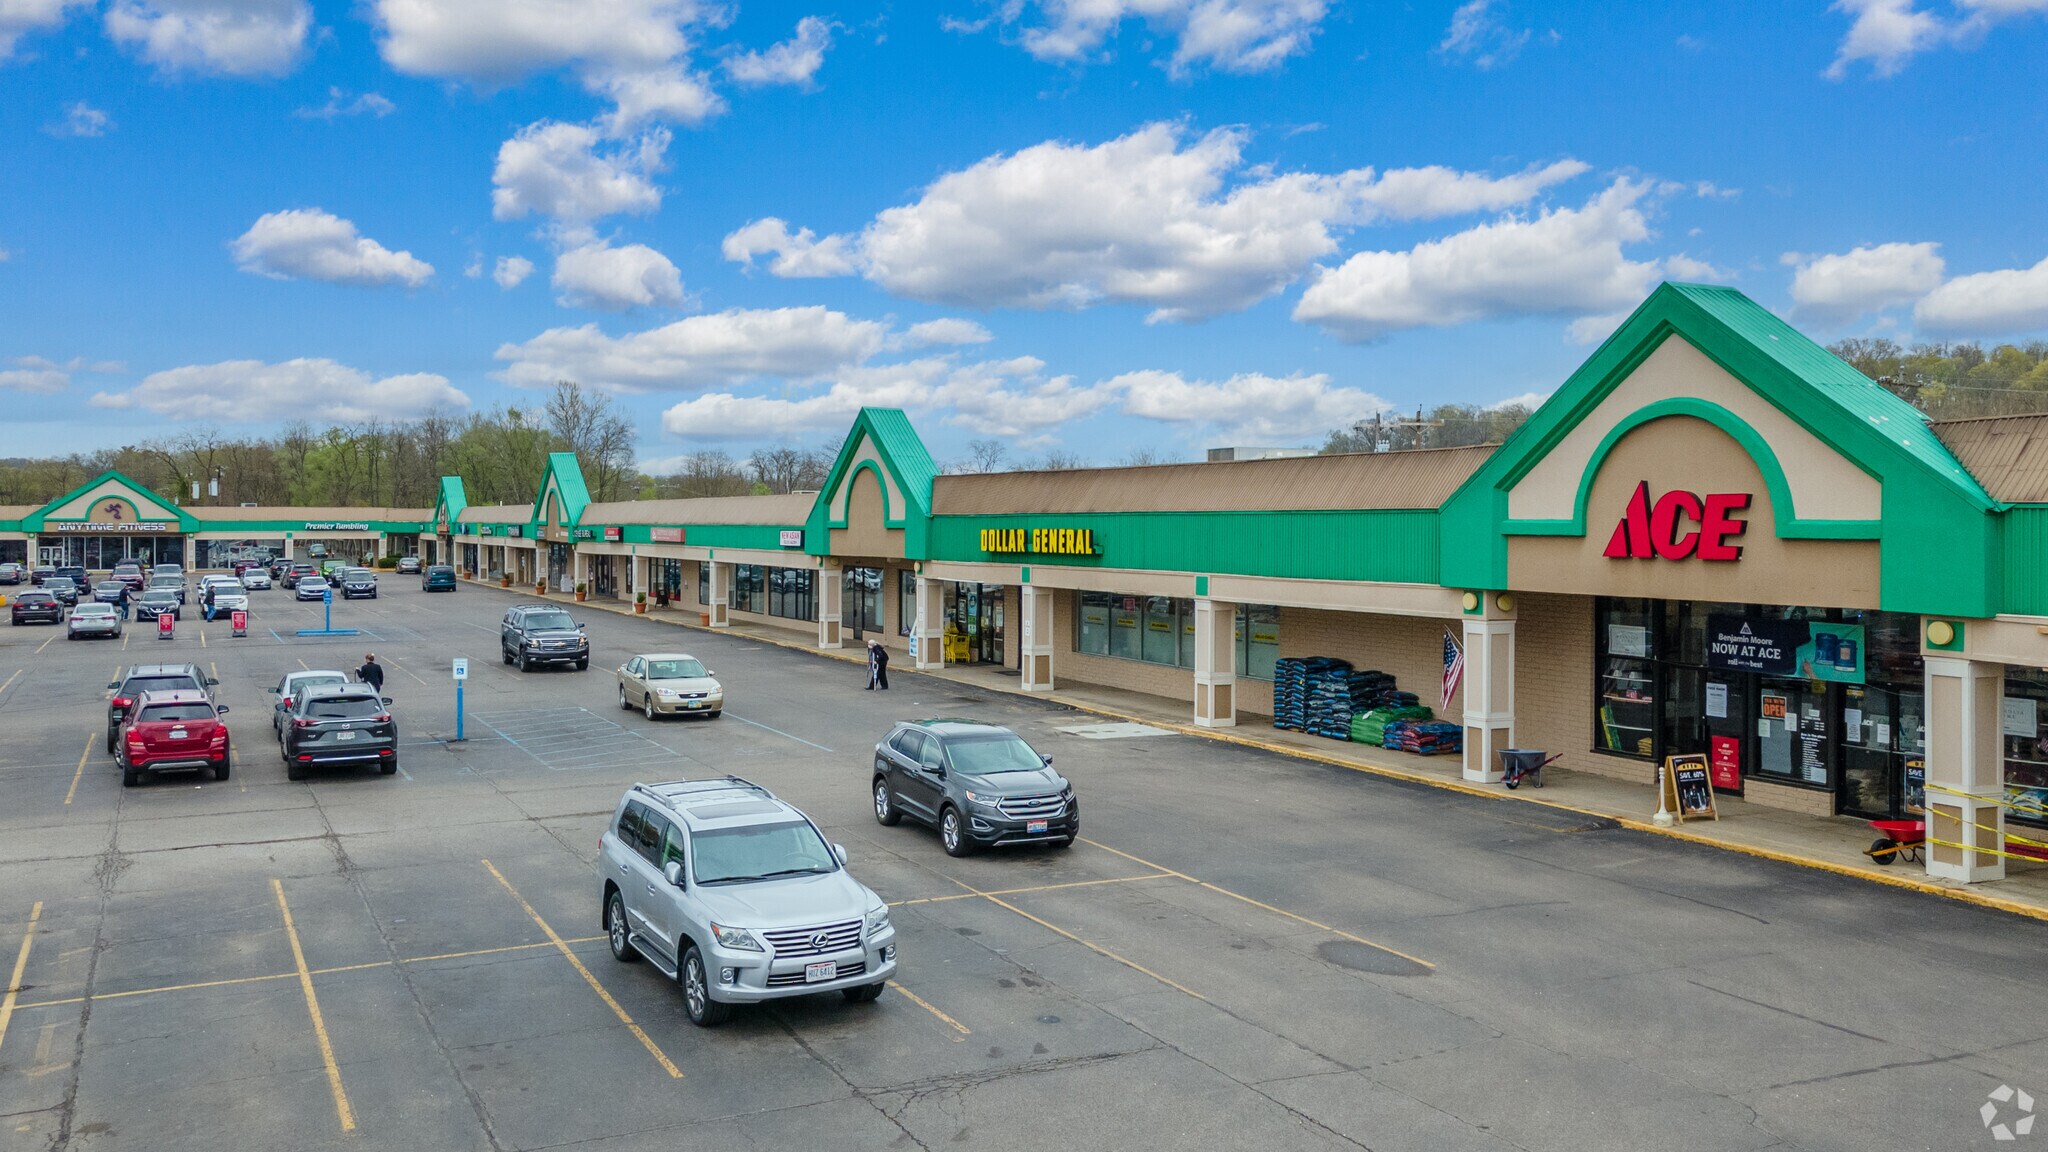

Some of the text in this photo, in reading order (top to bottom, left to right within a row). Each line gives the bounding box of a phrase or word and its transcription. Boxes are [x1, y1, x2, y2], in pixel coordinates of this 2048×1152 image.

[58, 522, 166, 531] ANYTIME FITNESS
[304, 522, 369, 531] Premier Tumbling
[1602, 480, 1752, 561] ACE
[980, 528, 1093, 555] DOLLAR GENERAL
[1718, 633, 1773, 645] Benjamin Moore
[1712, 643, 1781, 659] NOW AT ACE
[1750, 660, 1763, 668] best
[1764, 703, 1785, 717] OPEN
